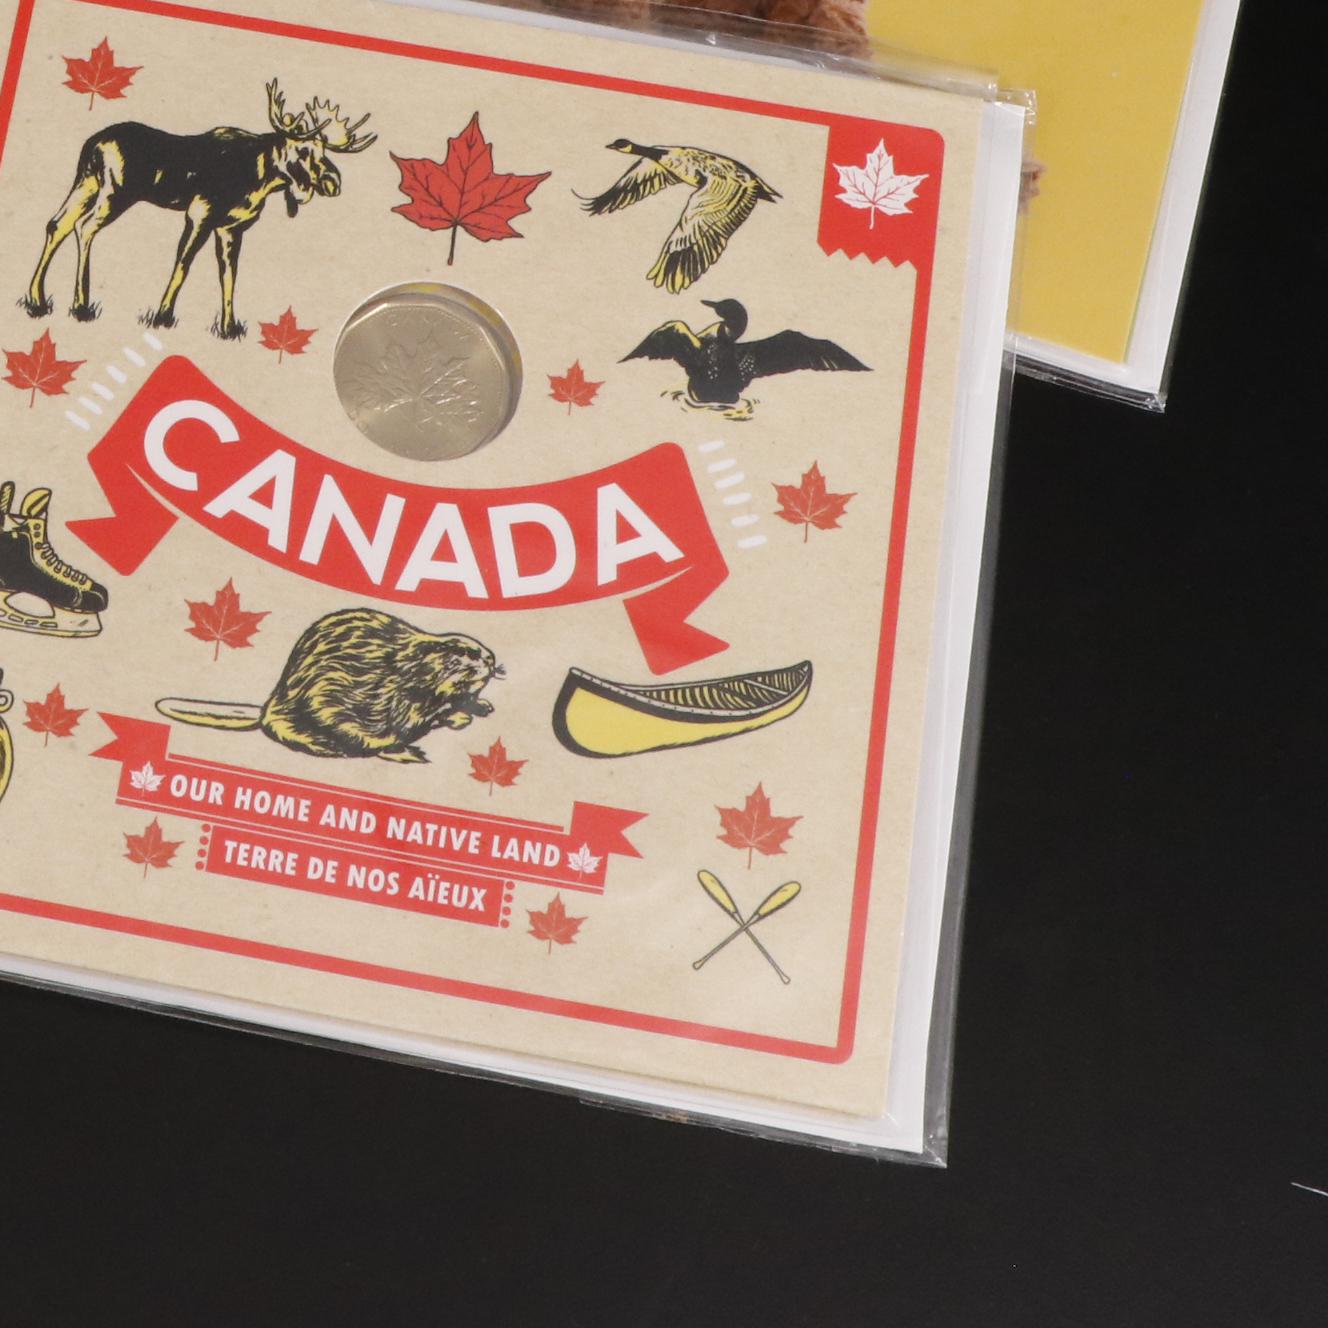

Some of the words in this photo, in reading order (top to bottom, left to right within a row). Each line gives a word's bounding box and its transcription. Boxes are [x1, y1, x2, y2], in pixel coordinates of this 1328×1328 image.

[143, 399, 685, 599] CANADA
[169, 774, 224, 806] OUR
[234, 787, 311, 823] HOME
[319, 803, 378, 835] AND
[386, 815, 481, 855] NATIVE
[490, 835, 562, 868] LAND
[223, 840, 298, 876] TERRE
[307, 856, 338, 883] DE
[346, 866, 401, 896] NOS
[408, 874, 487, 911] AÏEUX
